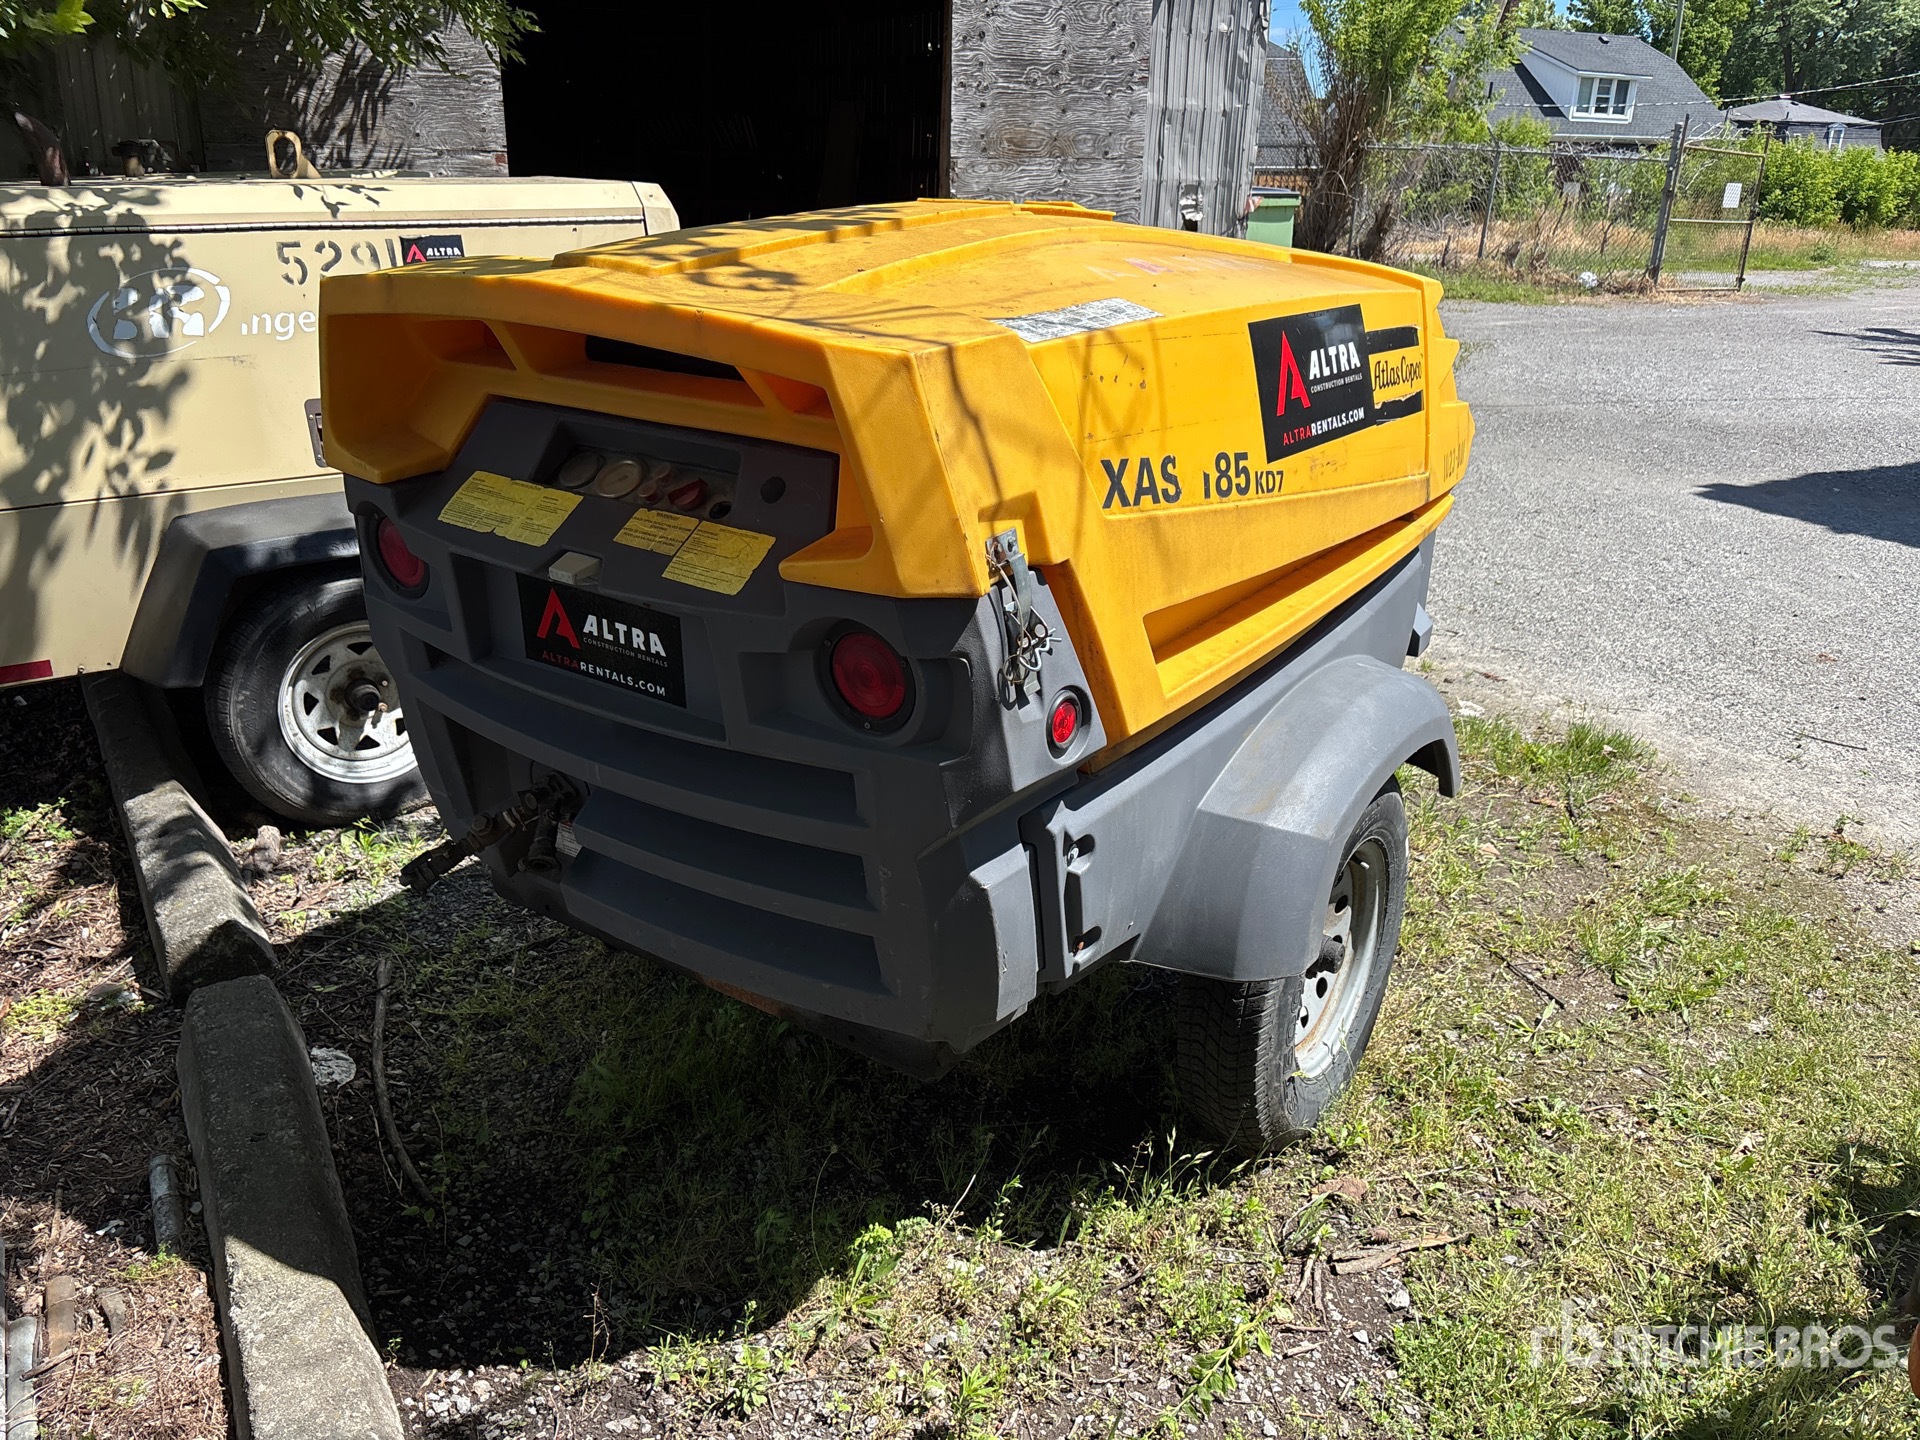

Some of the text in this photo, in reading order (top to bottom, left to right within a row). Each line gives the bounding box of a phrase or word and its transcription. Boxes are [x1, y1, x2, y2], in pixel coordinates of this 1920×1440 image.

[426, 247, 462, 256] ALTRA
[1309, 342, 1361, 380] ALTRA
[1373, 360, 1401, 392] Atlas
[1311, 373, 1363, 394] CONSTRUCTION RENTALS
[1283, 407, 1365, 446] ALTRARENTALS.COM
[1100, 455, 1182, 509] XAS
[1254, 470, 1284, 494] KD7
[583, 613, 667, 658] ALTRA
[583, 637, 668, 668] CONSTRUCTION RENTALS
[542, 650, 666, 697] ALTRARENTALS.COM
